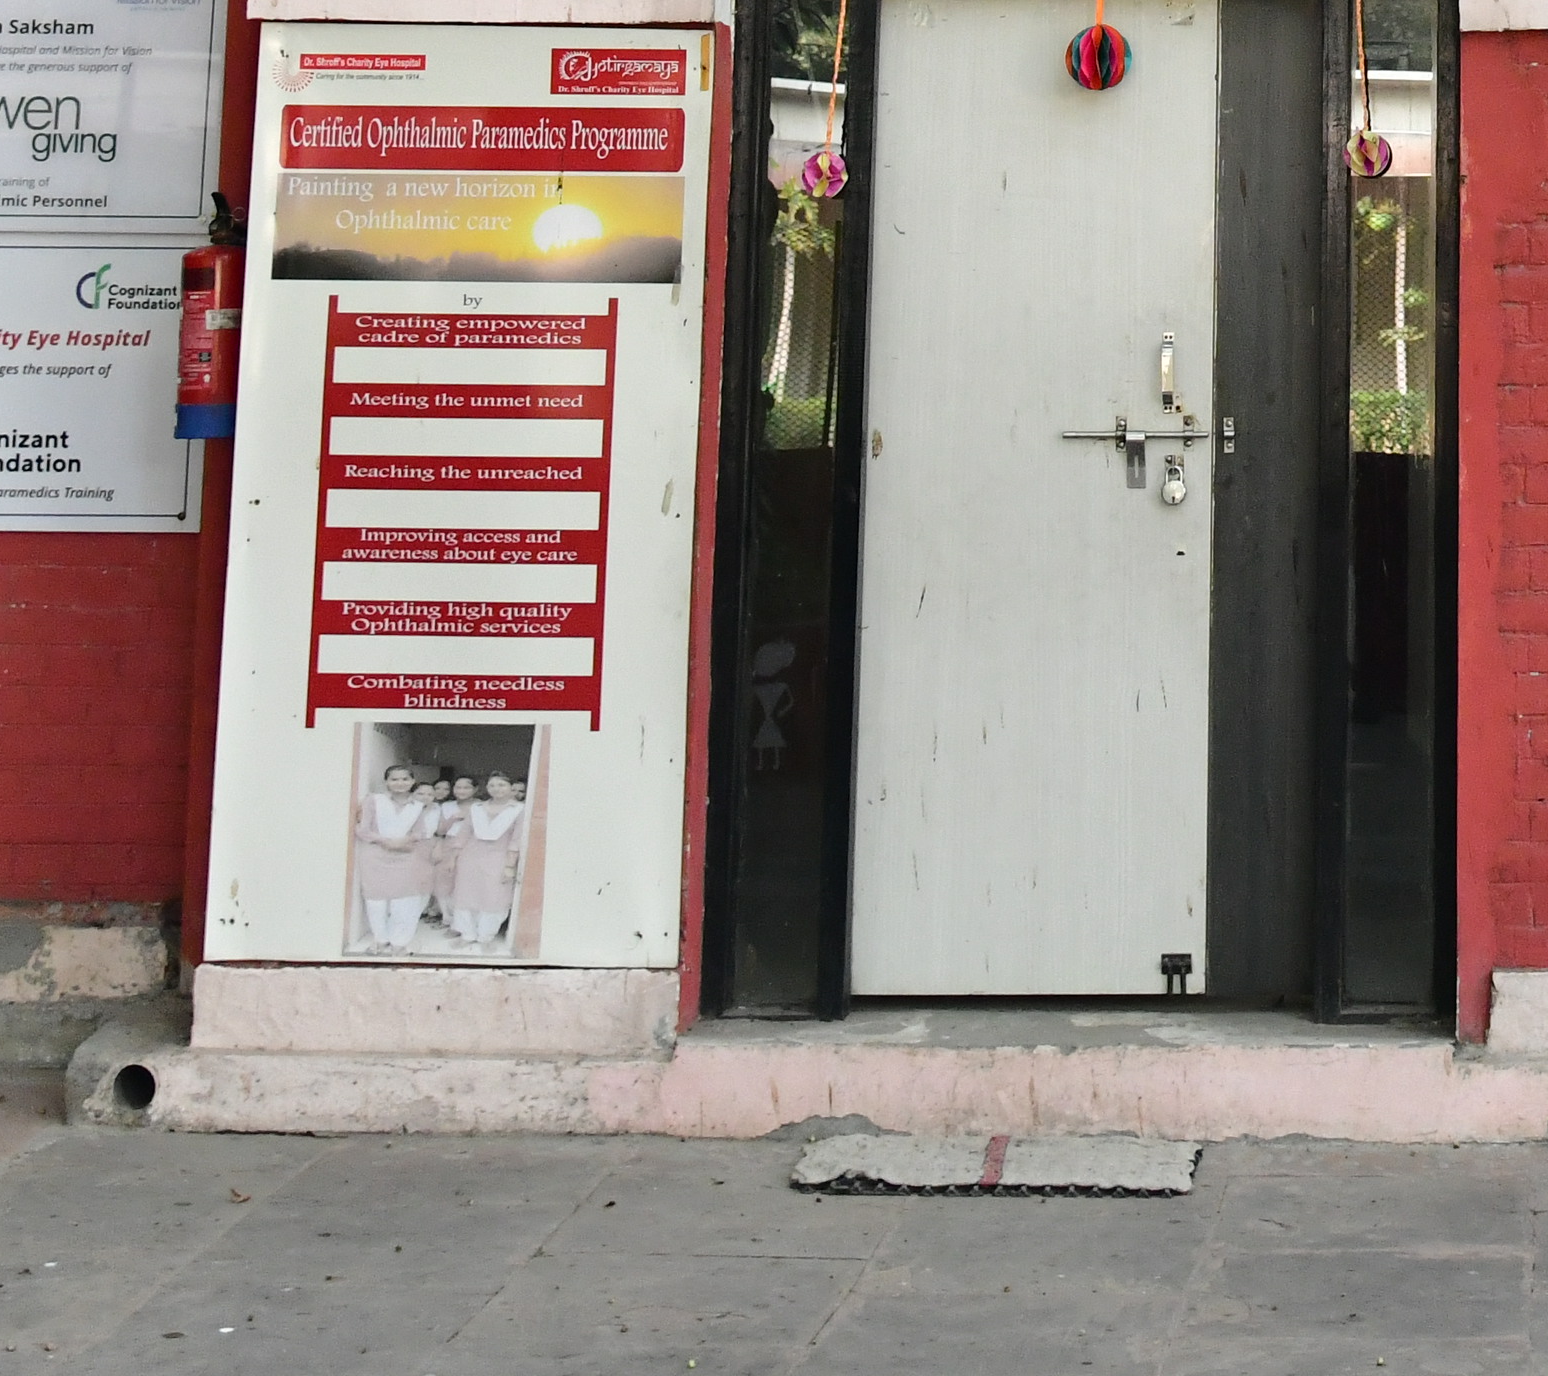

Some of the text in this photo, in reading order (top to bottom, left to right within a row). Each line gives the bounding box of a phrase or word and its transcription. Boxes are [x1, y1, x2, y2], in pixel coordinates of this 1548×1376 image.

[9, 20, 93, 34] Saksham
[291, 116, 668, 159] Certified Ophthalmic Paramedics Programme
[32, 131, 118, 162] giving
[289, 177, 373, 201] Painting
[386, 183, 396, 196] a
[405, 183, 449, 196] new
[455, 177, 535, 197] horizon
[33, 196, 107, 207] Personnel
[336, 208, 511, 235] Ophthalmic care
[109, 285, 177, 298] Cognizant
[464, 294, 482, 309] by
[356, 316, 585, 331] Creating empowered
[27, 330, 60, 350] Eye
[67, 330, 151, 351] Hospital
[359, 330, 581, 346] cadre of paramedics
[23, 364, 43, 375] the
[46, 366, 95, 378] support
[98, 364, 112, 378] of
[350, 393, 582, 409] Meeting the unmet need
[345, 465, 582, 481] Reaching the unreached
[361, 529, 560, 545] Improving access and
[342, 547, 577, 563] awareness about eye care
[343, 602, 572, 620] Providing high quality
[351, 619, 560, 634] Ophthalmic services
[348, 676, 564, 693] Combating needless
[405, 694, 506, 708] blindness
